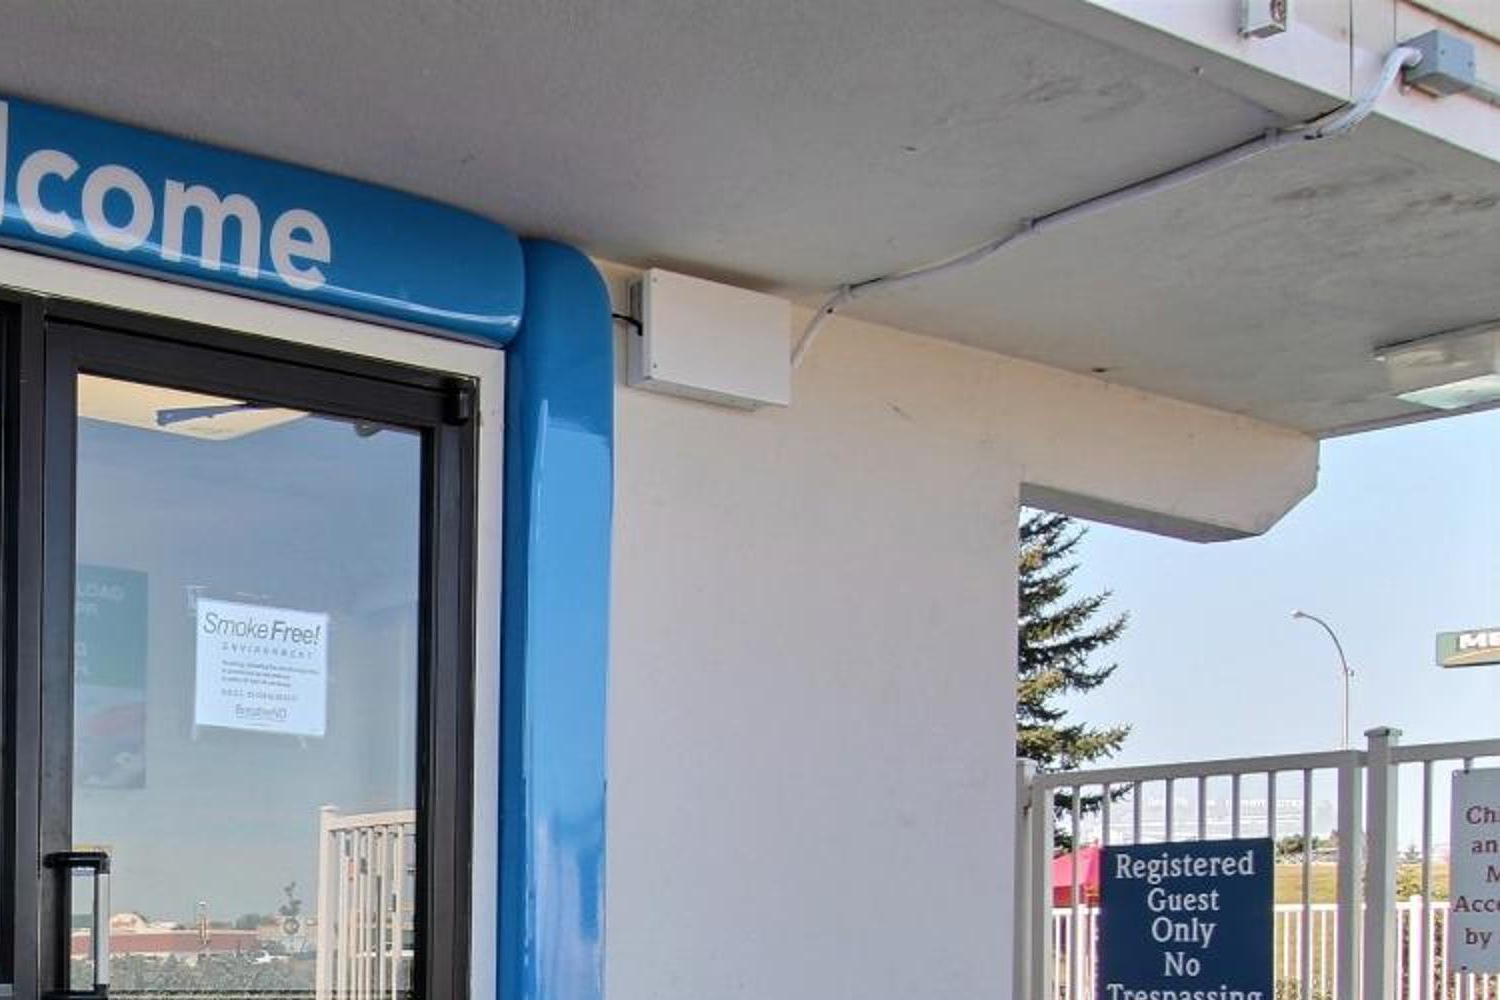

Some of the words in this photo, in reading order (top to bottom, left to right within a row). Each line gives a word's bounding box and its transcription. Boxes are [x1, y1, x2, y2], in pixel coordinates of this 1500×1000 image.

[203, 612, 269, 639] Smoke
[271, 620, 322, 646] Free!
[1115, 850, 1255, 885] Registered
[1147, 887, 1221, 912] Guest
[1151, 915, 1217, 949] Only
[1464, 927, 1493, 950] by
[1163, 951, 1201, 977] No
